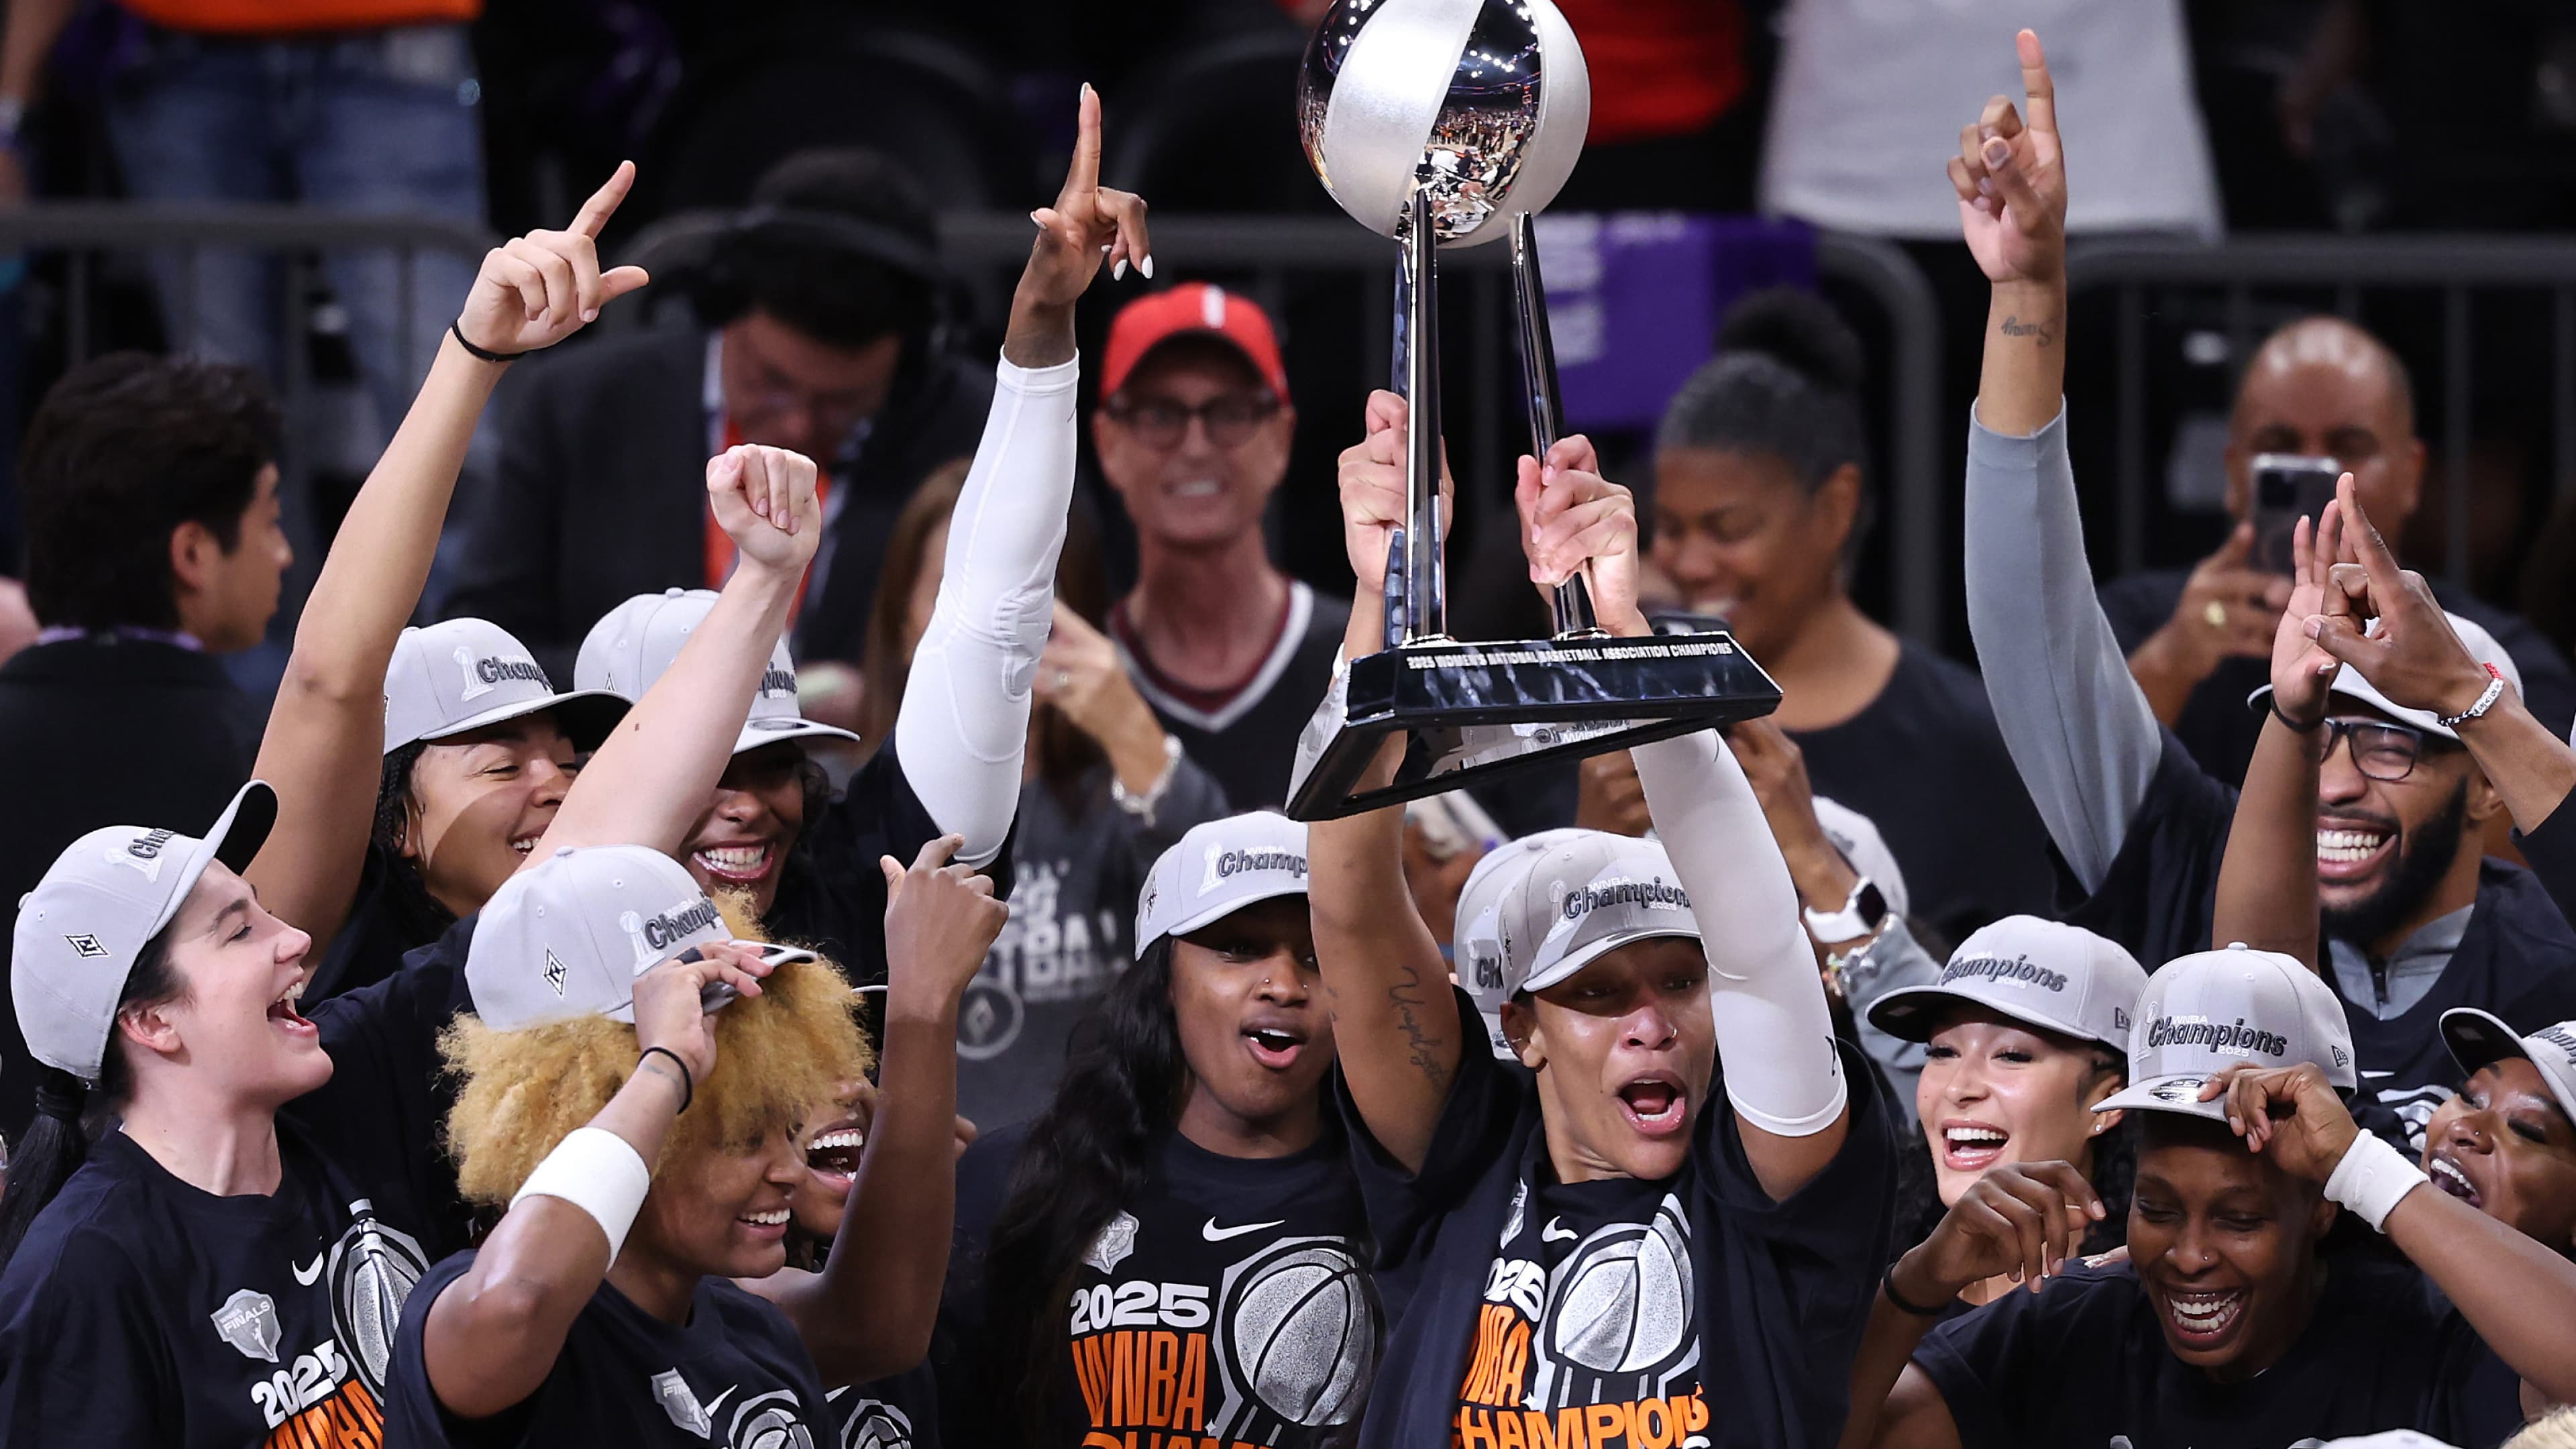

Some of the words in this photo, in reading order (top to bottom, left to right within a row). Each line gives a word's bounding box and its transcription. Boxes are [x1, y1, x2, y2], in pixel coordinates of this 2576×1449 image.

[1406, 655, 1436, 669] 2025
[1434, 653, 1487, 667] WOMEN'S
[1486, 651, 1538, 665] NATIONAL
[1537, 647, 1602, 663] BASKETBALL
[1602, 645, 1670, 660] ASSOCIATION
[1670, 642, 1733, 657] CHAMPIONS
[1217, 850, 1308, 879] Champ
[1245, 845, 1287, 856] WNBA
[1588, 875, 1631, 892] WNBA
[2171, 1014, 2208, 1024] WNBA
[2148, 1016, 2288, 1057] Champions
[2217, 1045, 2250, 1057] 2025
[1070, 1280, 1210, 1329] 2025
[1484, 1256, 1546, 1323] 025
[223, 1301, 270, 1334] FINALS
[251, 1338, 348, 1430] 2025
[1071, 1330, 1207, 1432] WNBA
